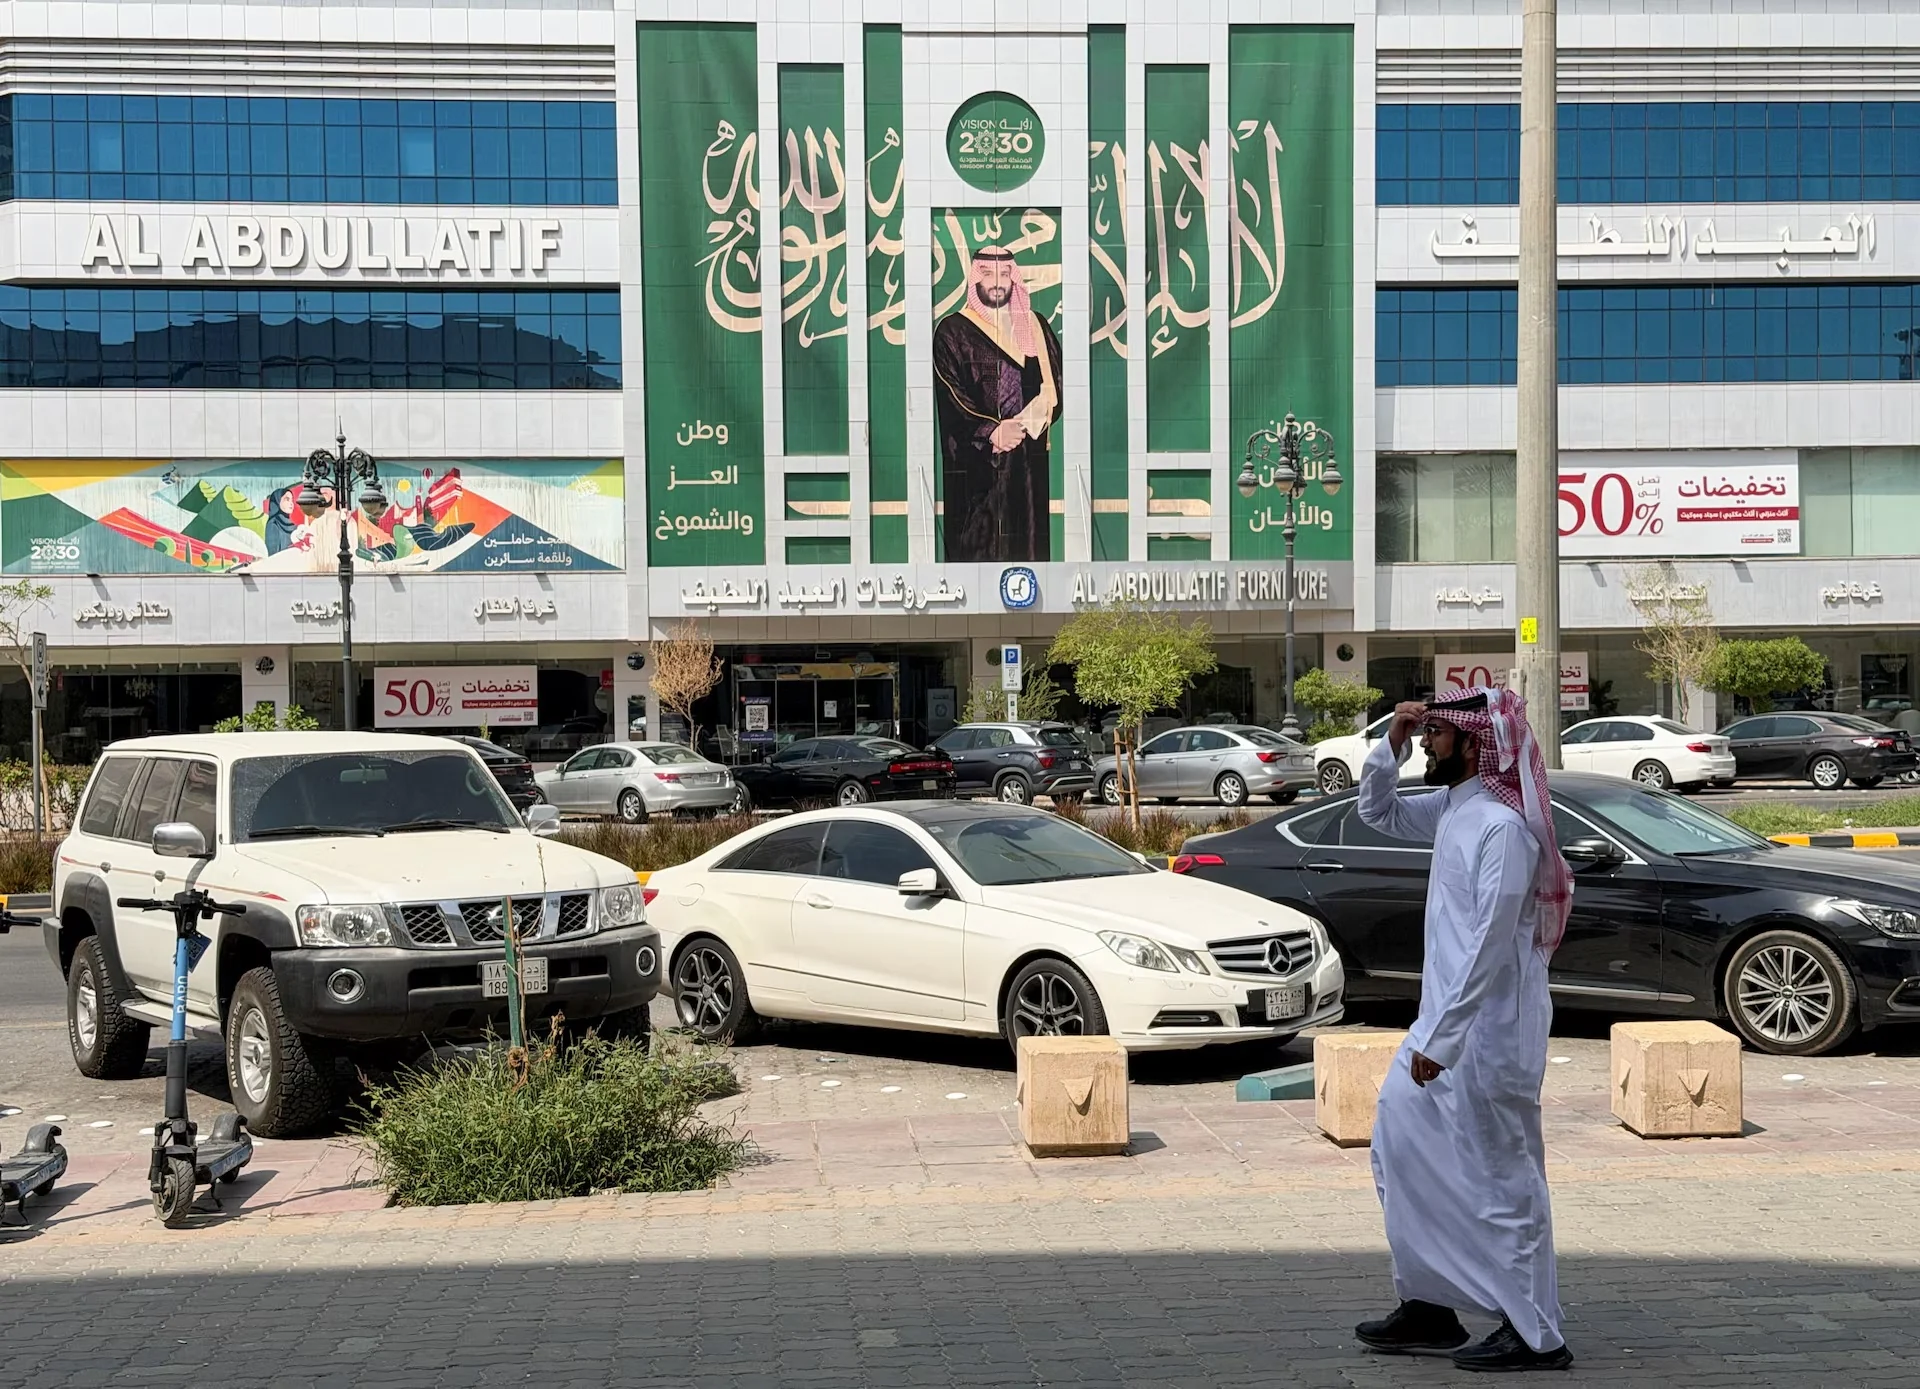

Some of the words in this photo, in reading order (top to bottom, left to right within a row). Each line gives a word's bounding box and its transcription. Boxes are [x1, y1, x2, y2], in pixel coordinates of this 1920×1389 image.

[959, 119, 996, 130] VISION
[959, 130, 1033, 154] 2030
[82, 214, 159, 268] AL
[183, 215, 561, 271] ABDULLATIF
[1432, 213, 1688, 260] اللطف
[1695, 213, 1877, 269] العبد
[676, 420, 729, 446] وطن
[667, 465, 738, 490] العز
[1258, 456, 1323, 488] الأن
[1678, 475, 1786, 504] تخفيضات
[655, 507, 754, 541] والشموخ
[30, 537, 56, 545] VISION
[681, 576, 769, 611] اللطيف
[778, 576, 846, 610] العبد
[856, 573, 968, 610] مفروشات
[1072, 572, 1098, 603] AL
[1112, 570, 1227, 602] ABDULLATIF
[1237, 570, 1328, 600] FURNIURE
[1007, 650, 1016, 662] P
[384, 679, 453, 718] 50%
[461, 679, 530, 698] تخفيضات
[488, 964, 508, 979] ١٨٩
[488, 980, 508, 995] 189
